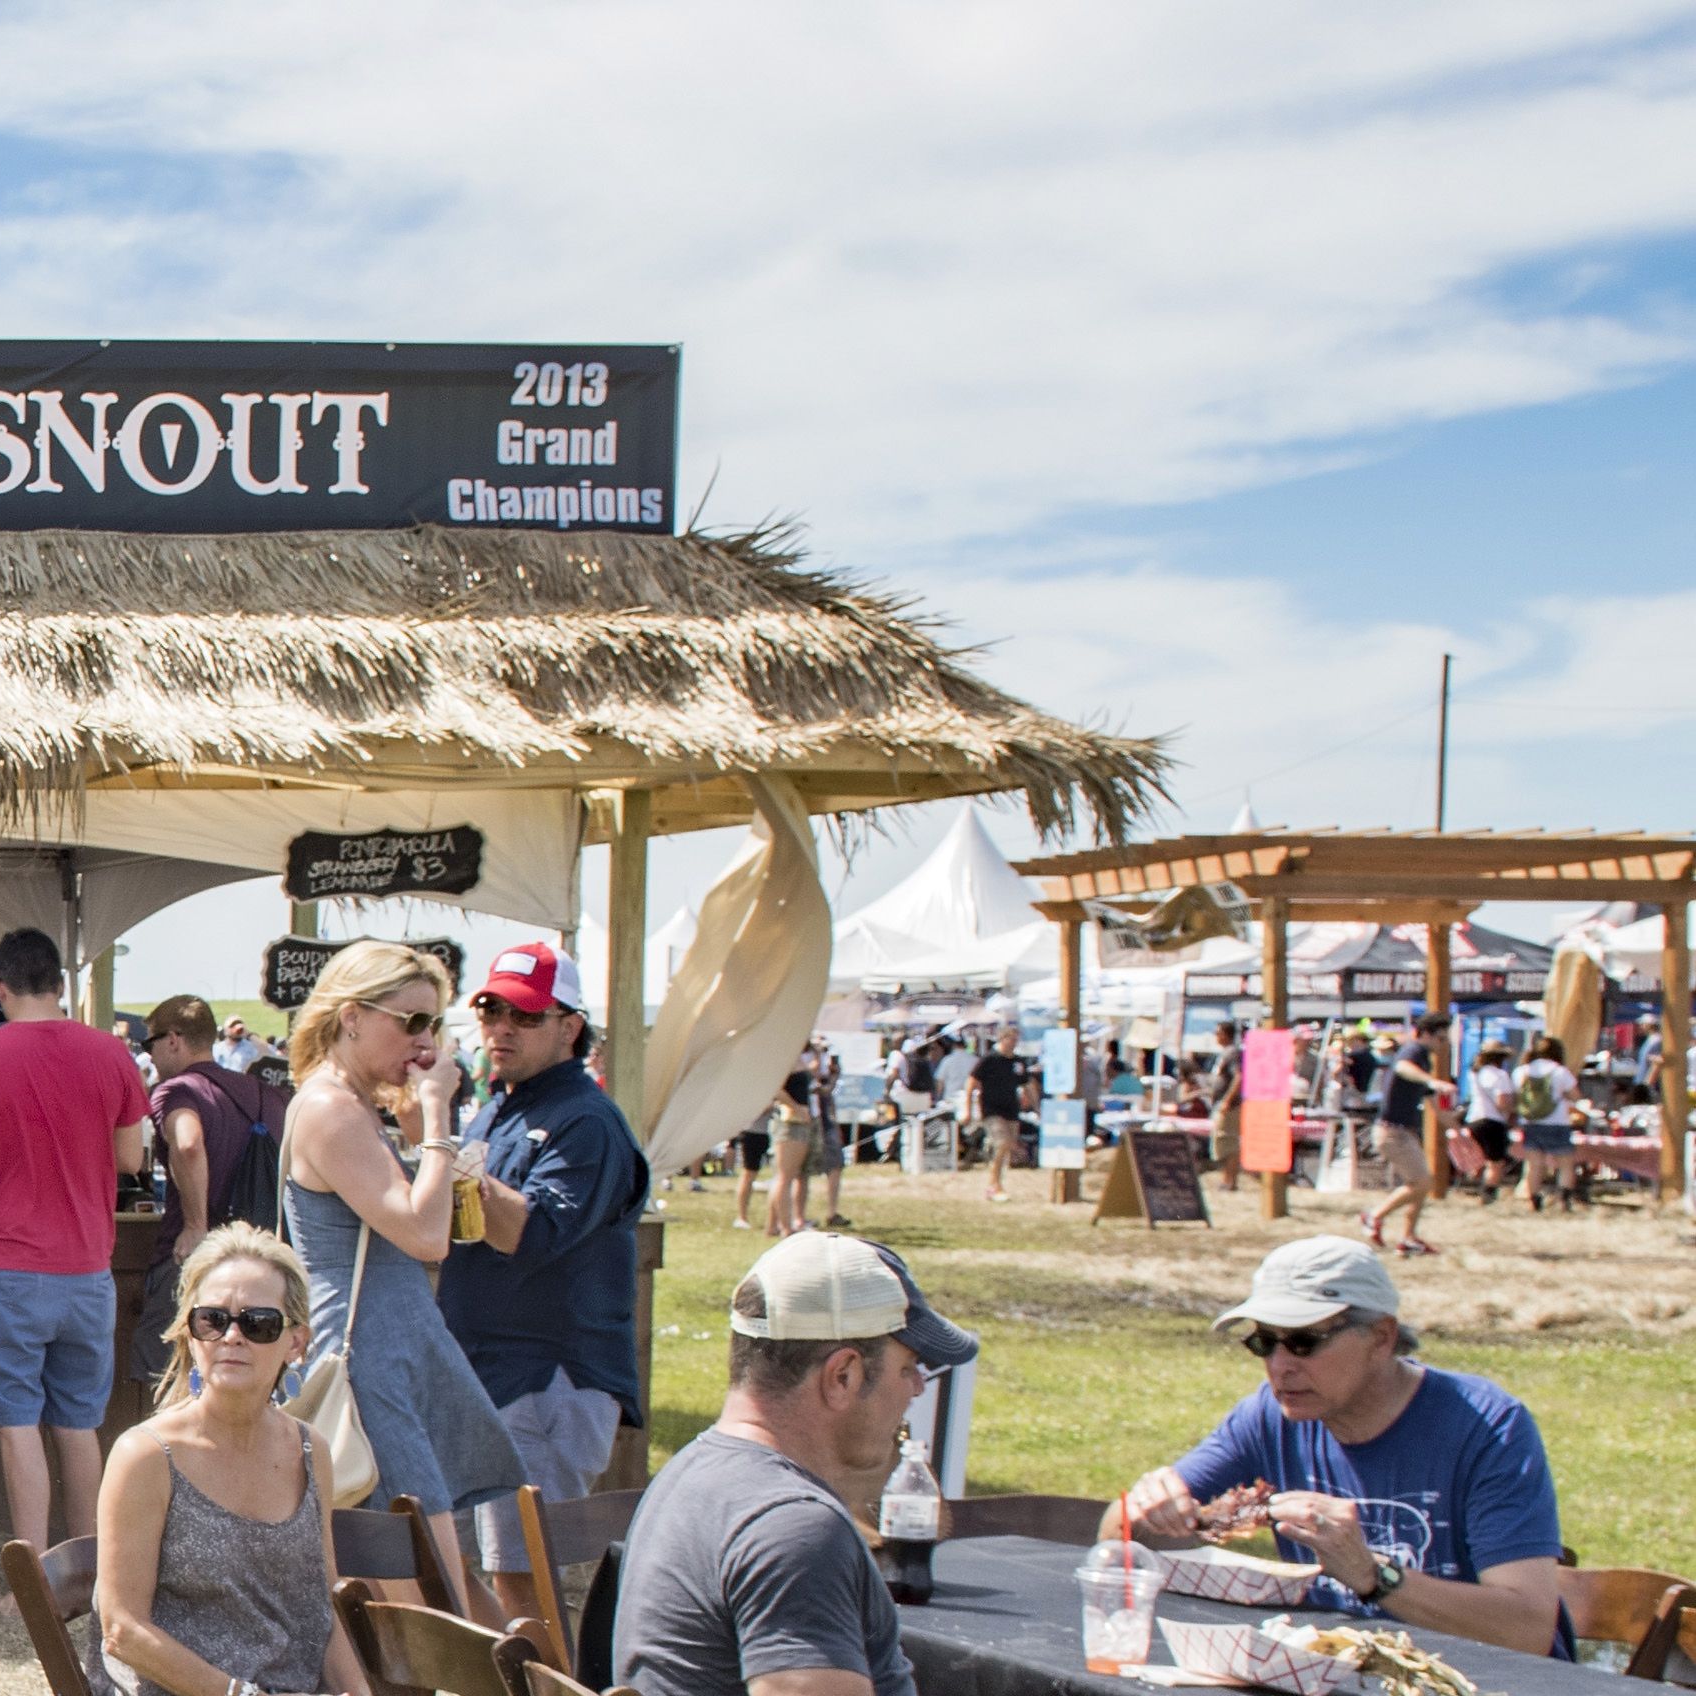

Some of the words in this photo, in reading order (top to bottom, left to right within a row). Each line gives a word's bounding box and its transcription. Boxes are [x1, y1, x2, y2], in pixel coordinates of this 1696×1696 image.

[510, 361, 609, 407] 2013
[497, 419, 618, 465] Grand
[447, 478, 663, 528] Champions
[412, 856, 447, 882] $3
